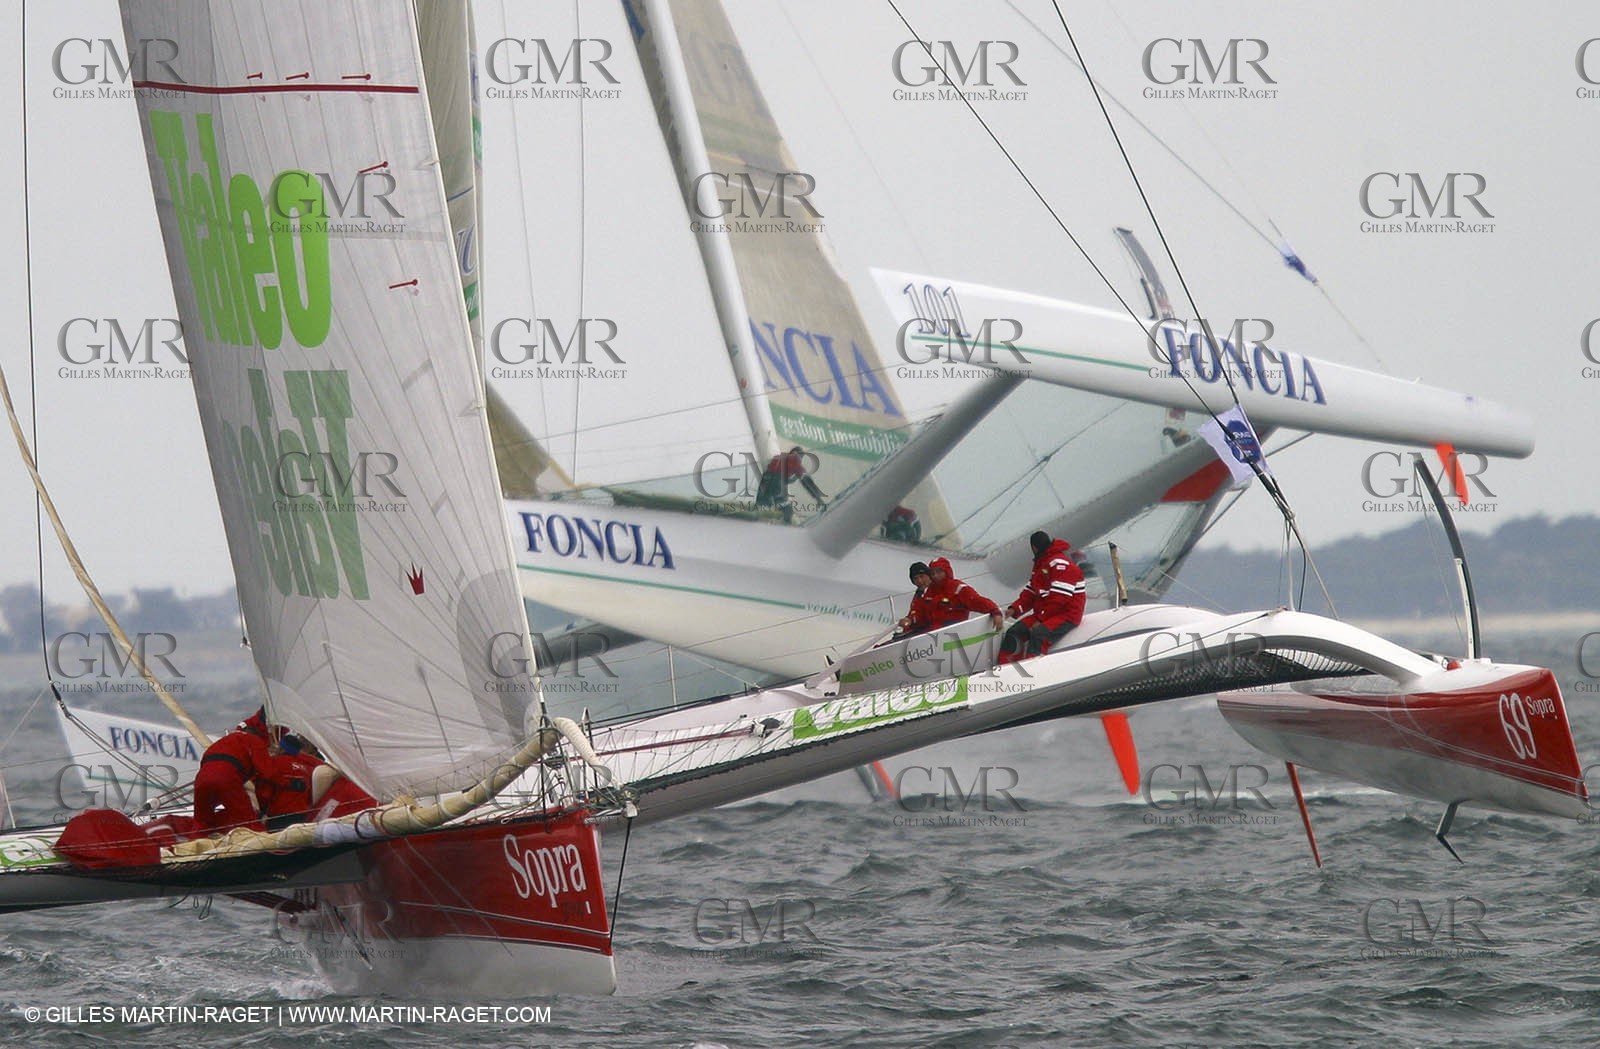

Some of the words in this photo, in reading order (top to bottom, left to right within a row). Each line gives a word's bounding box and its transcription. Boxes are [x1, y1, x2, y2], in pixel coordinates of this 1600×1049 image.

[903, 283, 971, 338] 101
[1161, 326, 1327, 405] FONCIA
[517, 510, 676, 571] FONCIA
[862, 659, 896, 679] valeo
[899, 644, 934, 666] added
[109, 726, 198, 762] FONCIA
[1499, 692, 1537, 760] 69
[1524, 695, 1556, 719] Sopra
[503, 833, 588, 909] Sopra
